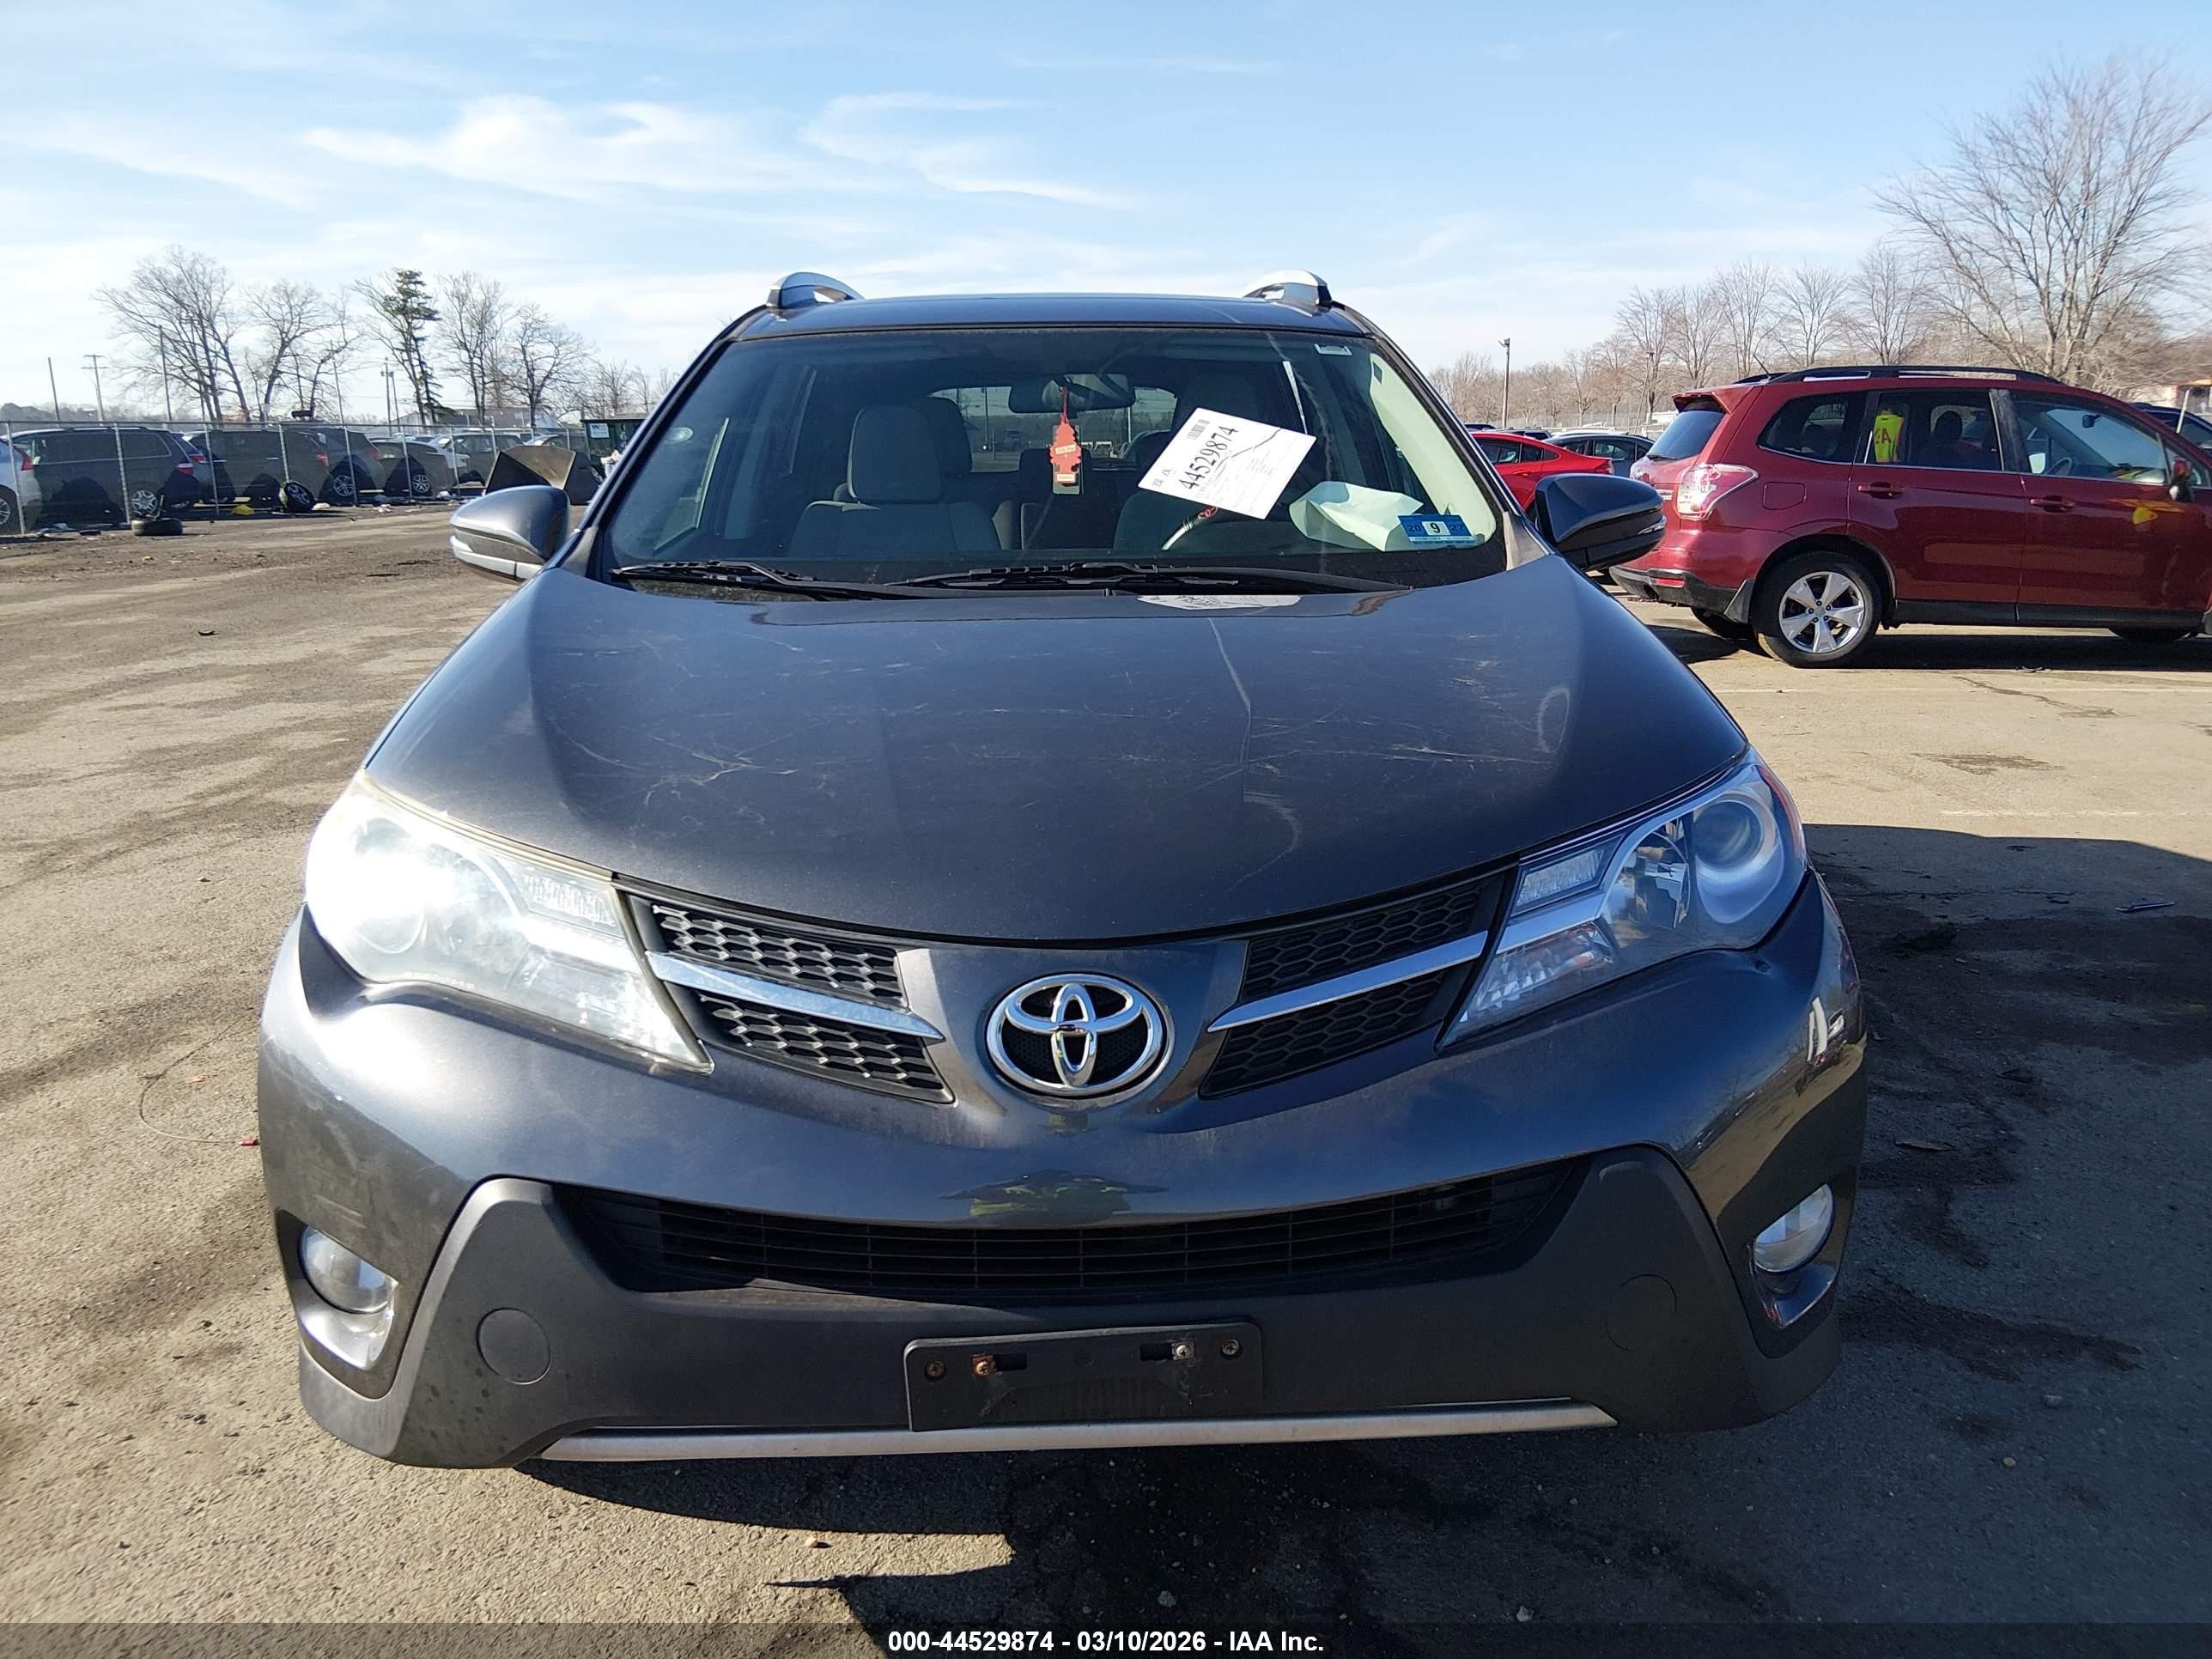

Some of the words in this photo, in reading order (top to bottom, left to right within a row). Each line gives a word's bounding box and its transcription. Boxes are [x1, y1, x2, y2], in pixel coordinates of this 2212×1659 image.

[1178, 426, 1238, 489] 44529874
[1407, 524, 1422, 532] 20
[1430, 522, 1441, 533] 9
